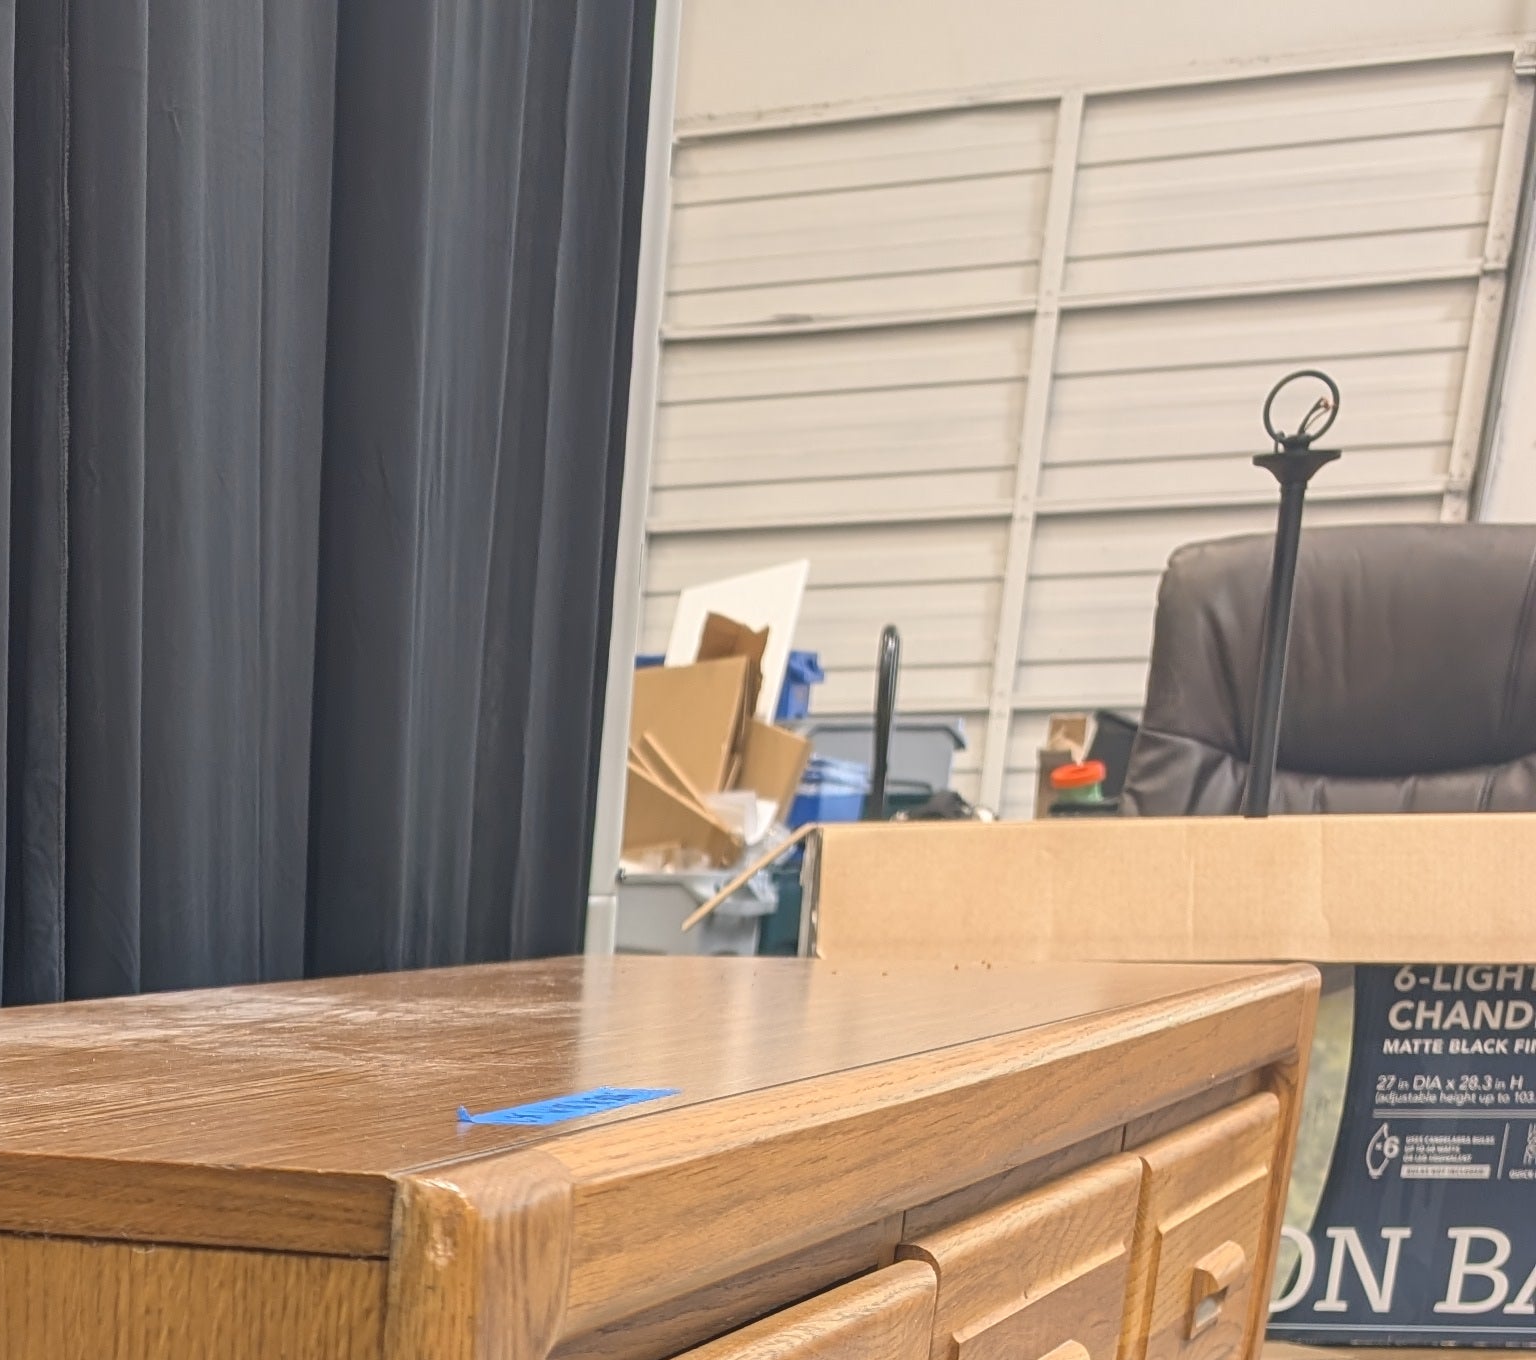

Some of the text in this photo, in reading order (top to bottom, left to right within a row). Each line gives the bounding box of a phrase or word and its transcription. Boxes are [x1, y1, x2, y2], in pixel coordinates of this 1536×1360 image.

[1388, 999, 1536, 1031] CHAND
[1383, 1038, 1443, 1055] MATTE
[1449, 1038, 1509, 1055] BLACK
[1376, 1074, 1397, 1091] 27
[1412, 1074, 1442, 1091] DIA
[1445, 1078, 1456, 1091] x
[1458, 1074, 1493, 1091] 28.3
[1510, 1074, 1524, 1091] H
[1375, 1091, 1437, 1106] (adjustable
[1439, 1091, 1476, 1106] height
[1478, 1093, 1495, 1106] up
[1497, 1092, 1510, 1104] to
